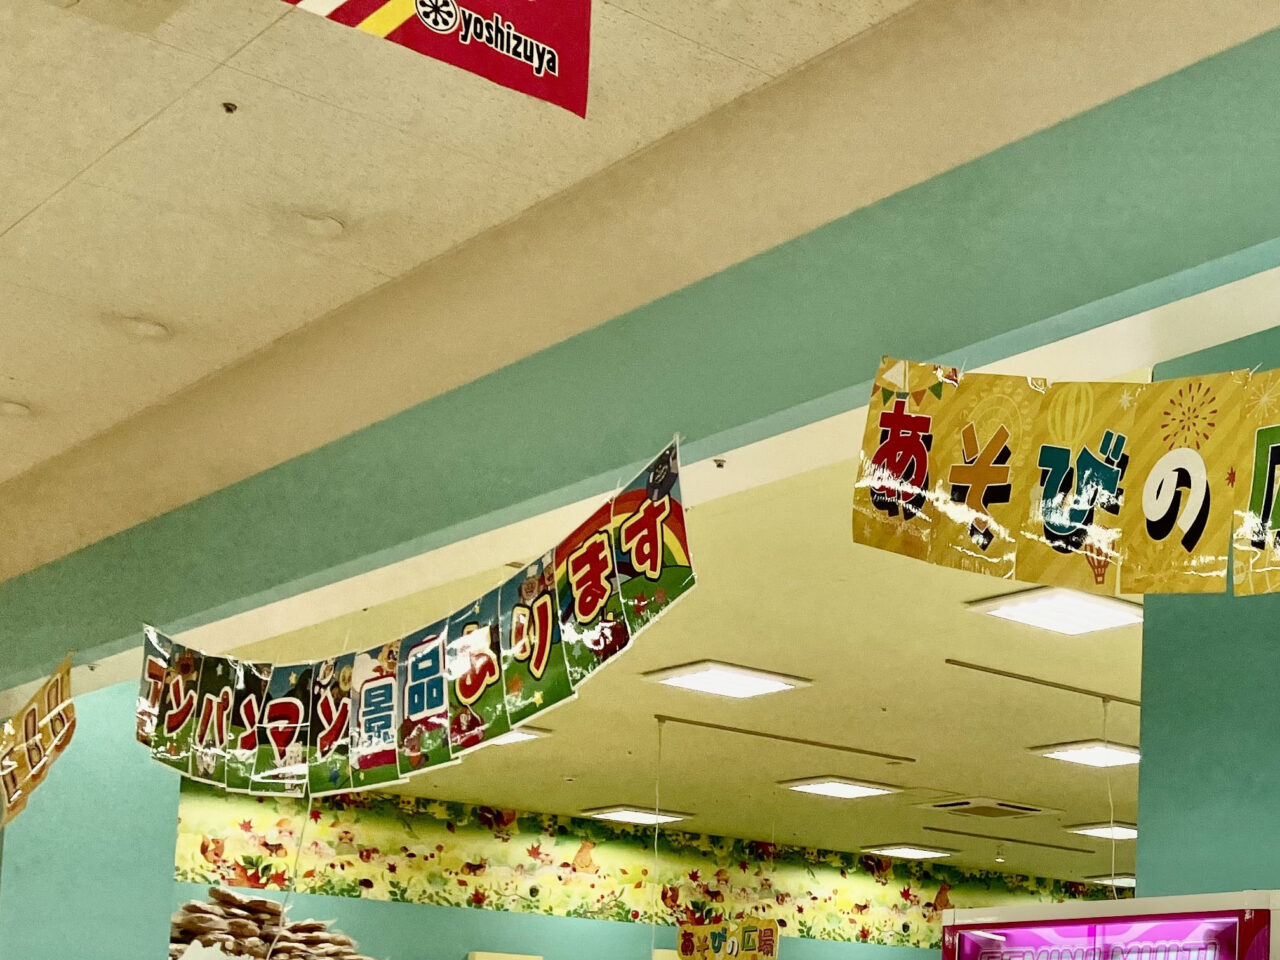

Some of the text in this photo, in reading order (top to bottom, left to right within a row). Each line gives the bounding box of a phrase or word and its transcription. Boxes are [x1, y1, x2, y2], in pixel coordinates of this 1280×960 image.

[460, 9, 558, 76] yoshizuya
[681, 925, 775, 960] あそびの広場
